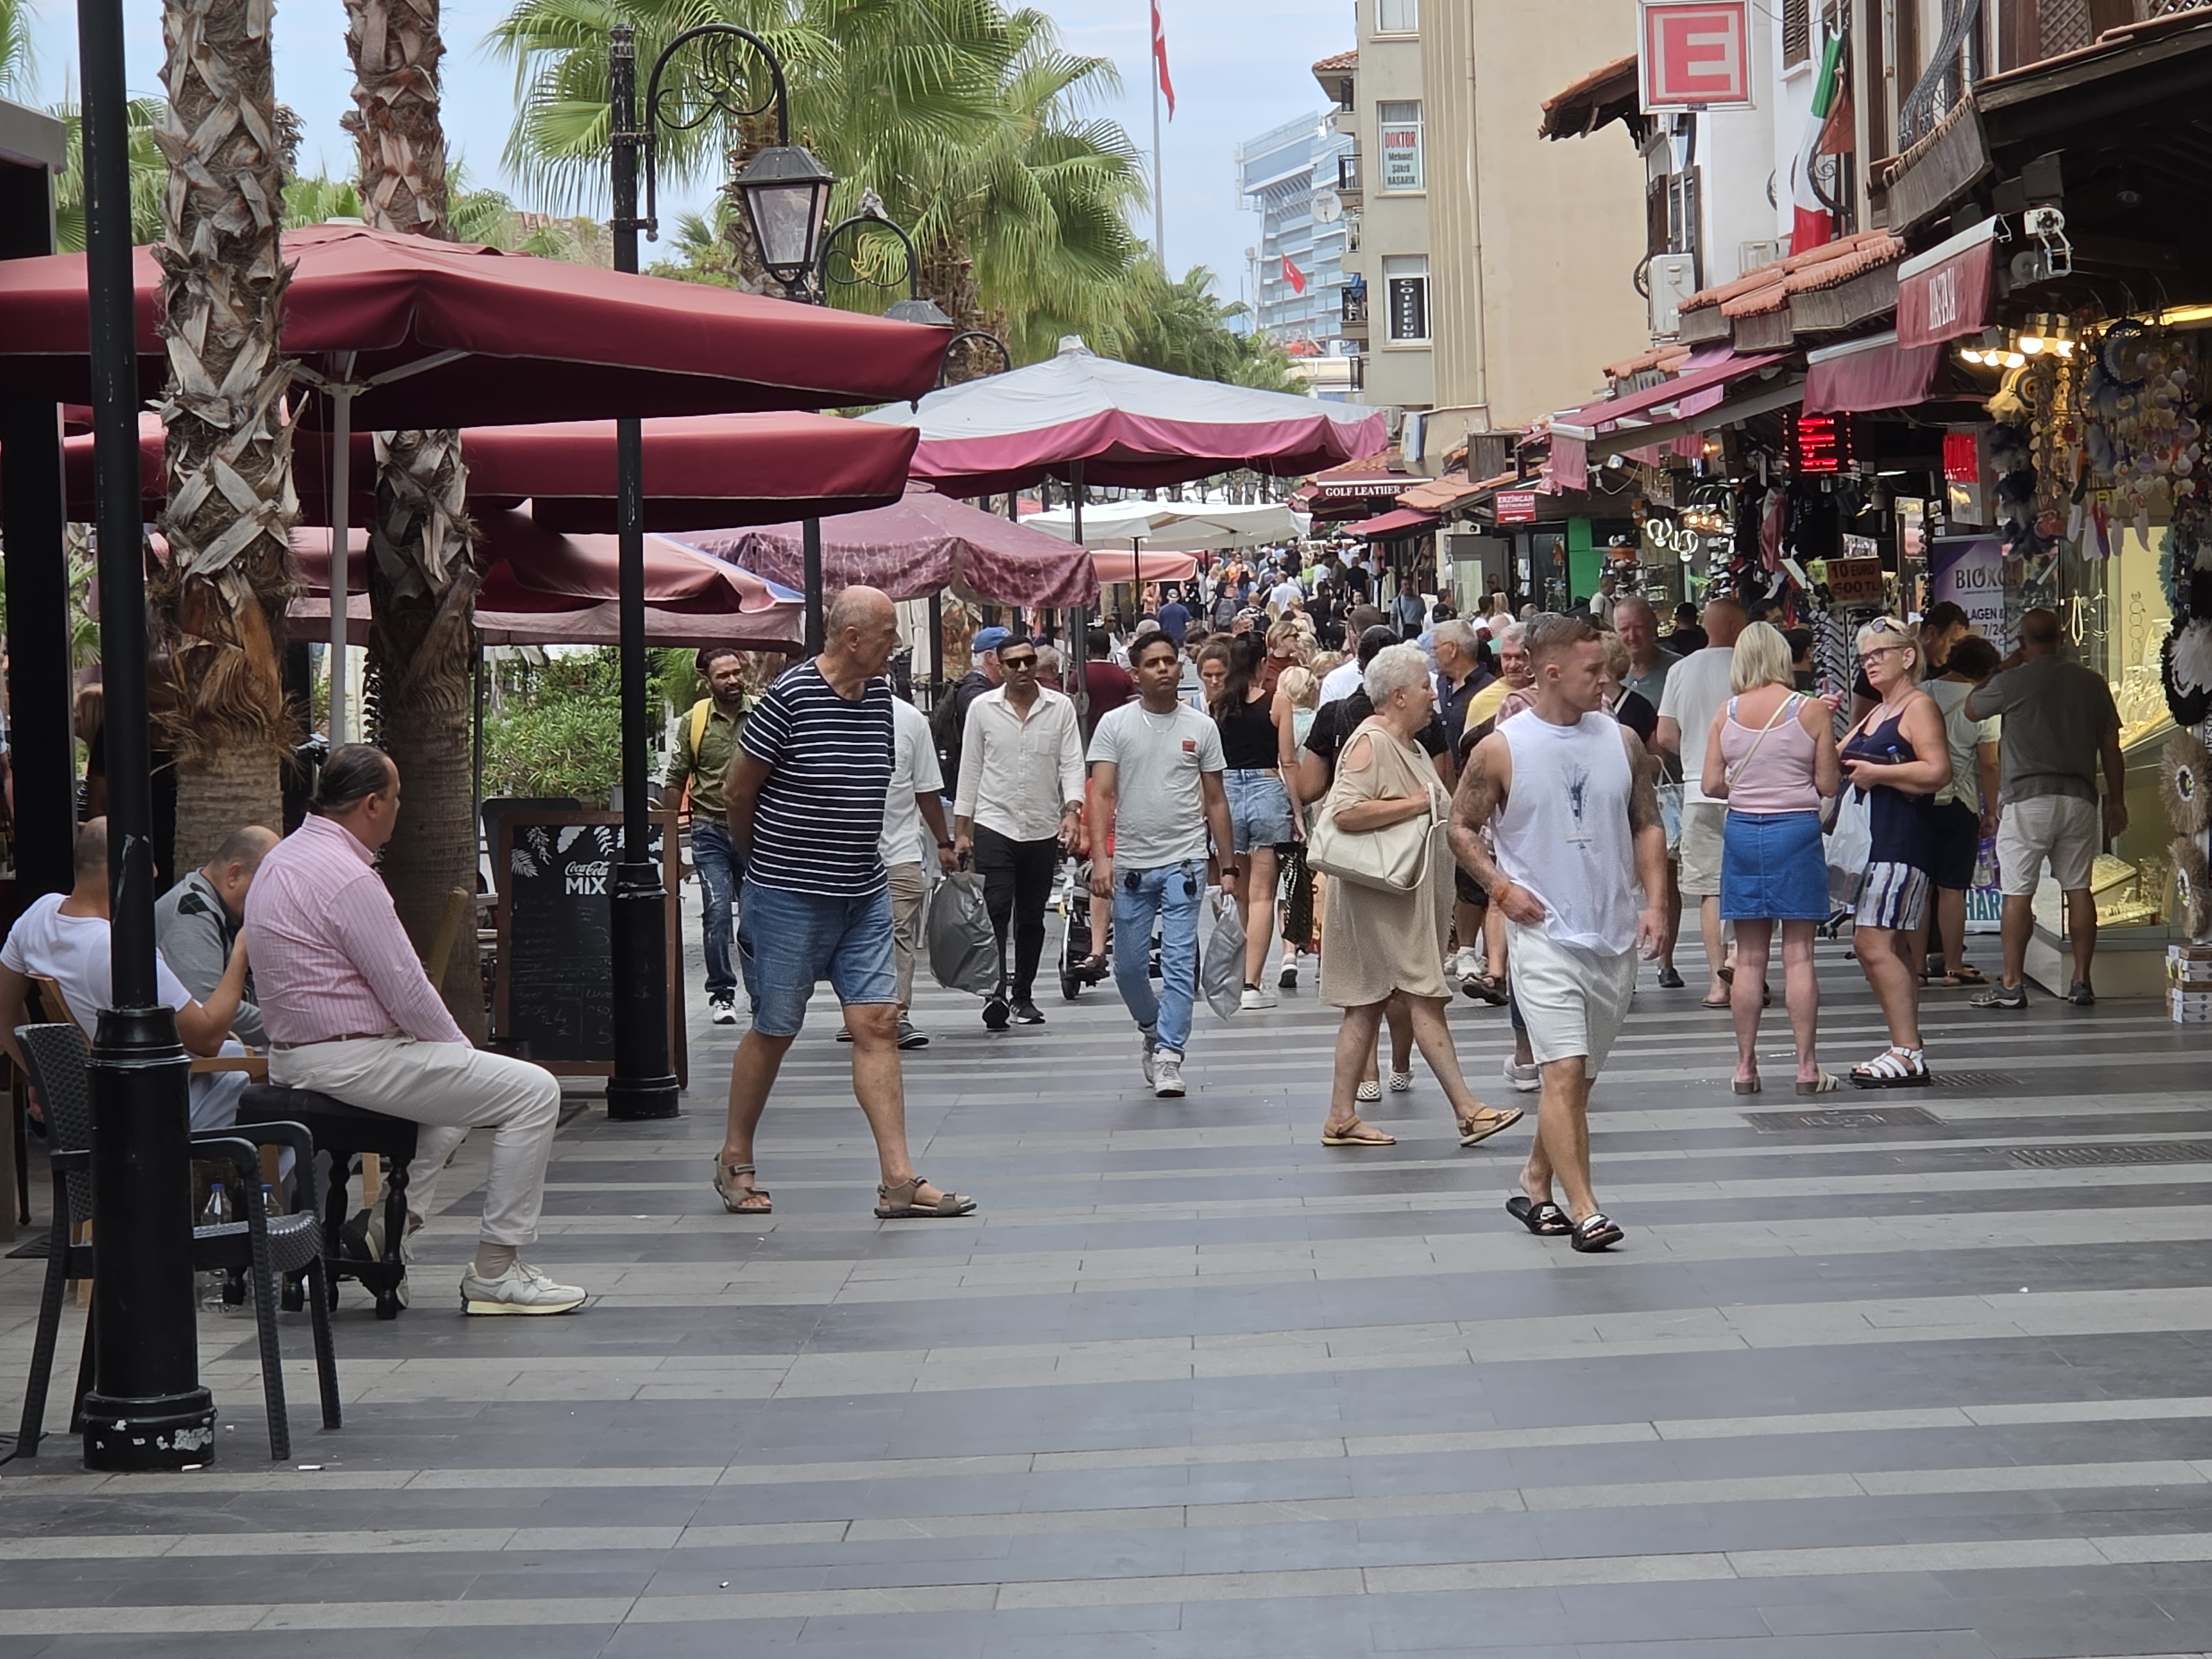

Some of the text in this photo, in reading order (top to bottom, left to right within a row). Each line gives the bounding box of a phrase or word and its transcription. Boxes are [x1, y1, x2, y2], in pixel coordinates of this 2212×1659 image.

[1663, 15, 1731, 93] E
[1385, 131, 1416, 149] DOKTOR
[1388, 153, 1413, 161] Mehmet
[1400, 280, 1414, 337] COIFFEUR
[1325, 487, 1353, 497] GOLF
[1355, 486, 1401, 495] LEATHER
[1831, 563, 1875, 578] 10 EURO
[1864, 581, 1879, 592] TL
[565, 877, 607, 895] MIX
